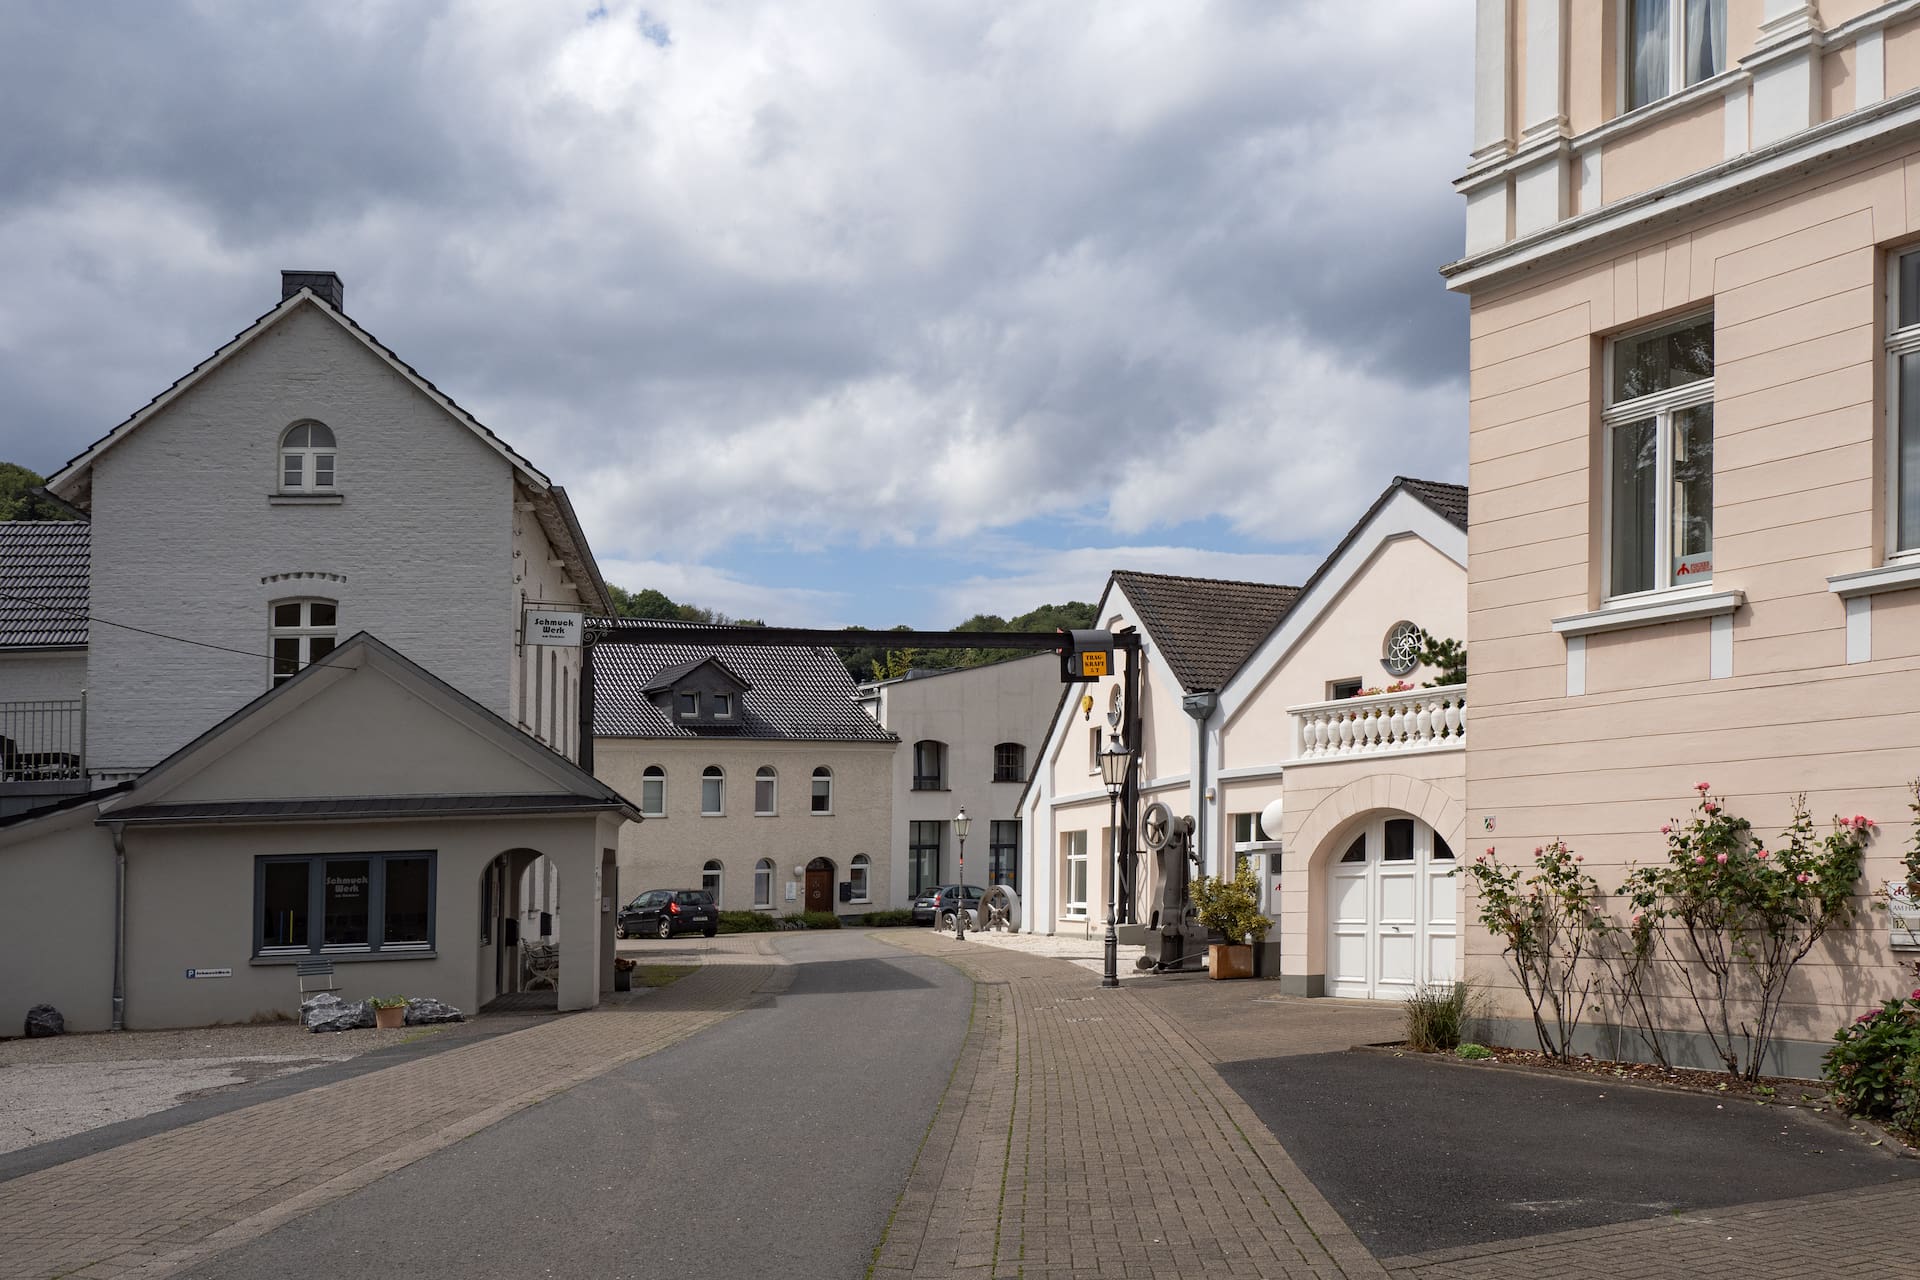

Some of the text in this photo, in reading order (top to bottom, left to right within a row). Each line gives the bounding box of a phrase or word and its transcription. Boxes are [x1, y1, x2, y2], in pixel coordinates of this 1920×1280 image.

[534, 618, 574, 627] Schmuck
[542, 626, 565, 634] Werk
[326, 876, 368, 885] Schmuck
[335, 884, 360, 892] Werk
